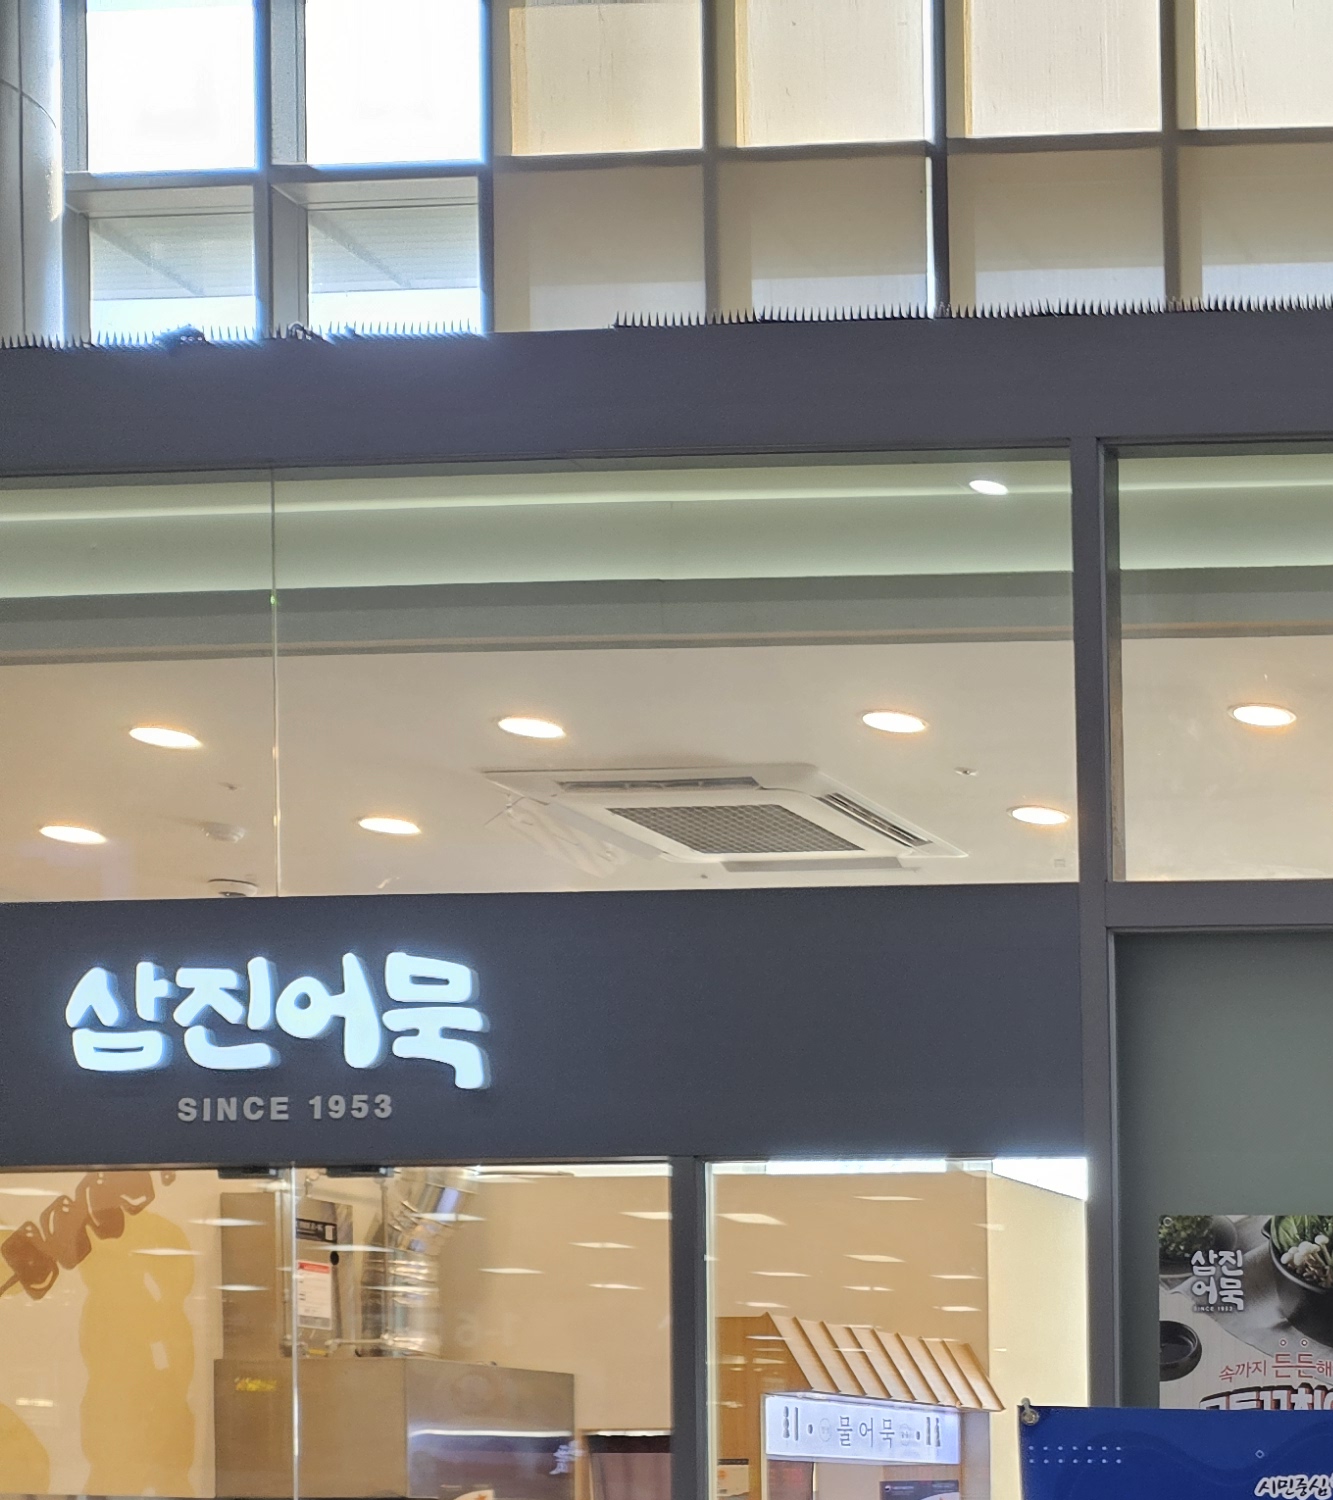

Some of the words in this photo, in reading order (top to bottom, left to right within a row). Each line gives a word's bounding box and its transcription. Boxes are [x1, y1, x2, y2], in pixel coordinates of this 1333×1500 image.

[65, 951, 488, 1089] 삼진어묵
[178, 1096, 289, 1121] SINCE
[308, 1094, 394, 1120] 1953
[1191, 1250, 1243, 1276] 삼진
[1192, 1276, 1243, 1310] 어묵
[1219, 1360, 1267, 1383] 속까지
[837, 1416, 895, 1448] 물어묵
[1258, 1475, 1329, 1497] 시민중심
